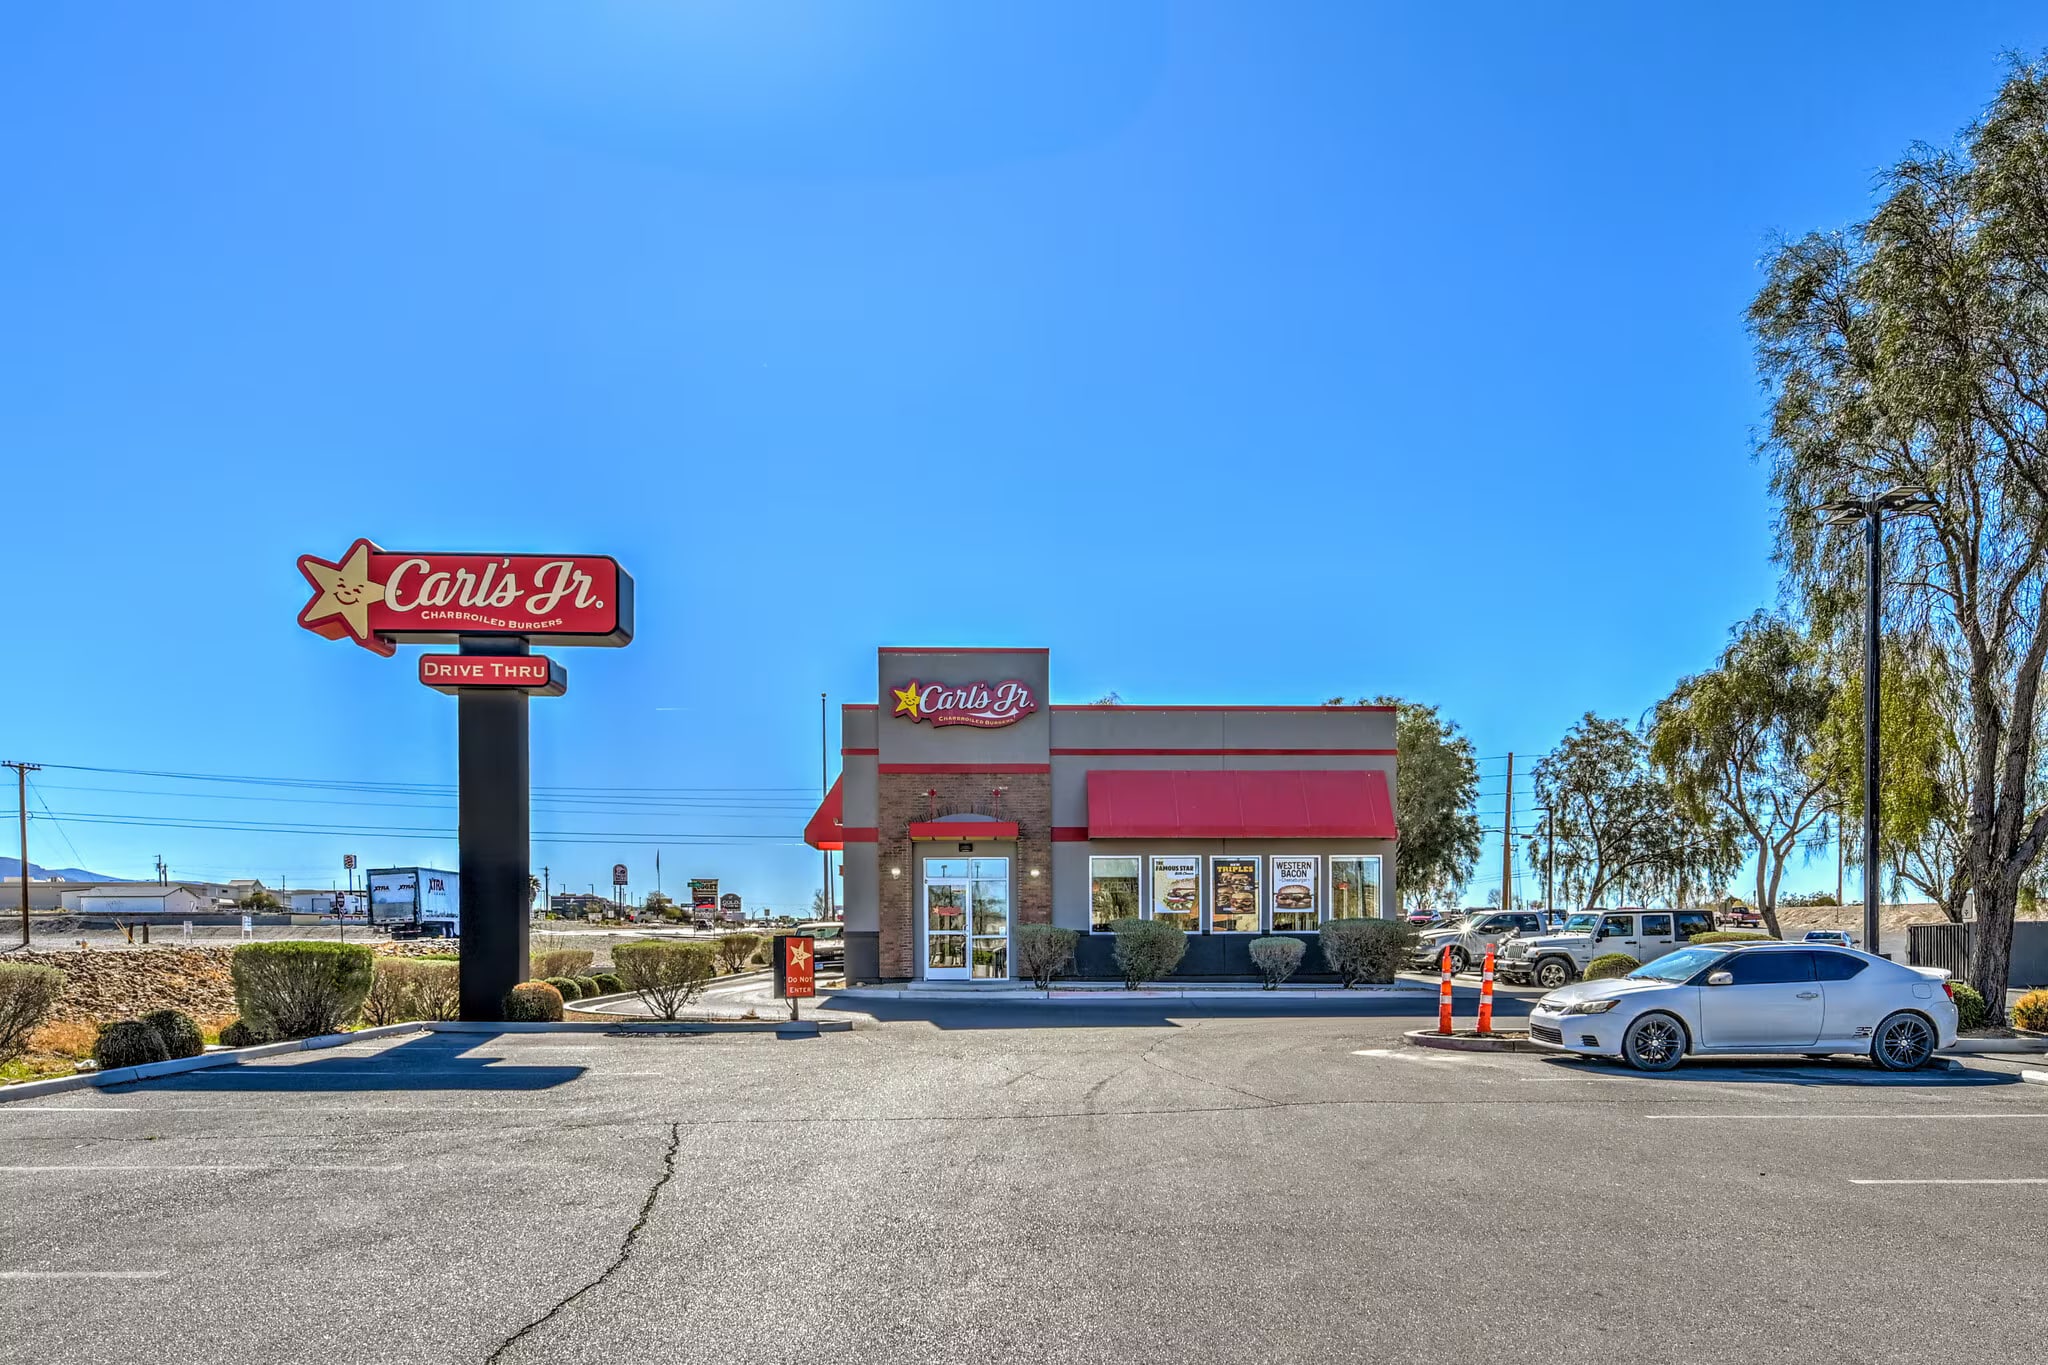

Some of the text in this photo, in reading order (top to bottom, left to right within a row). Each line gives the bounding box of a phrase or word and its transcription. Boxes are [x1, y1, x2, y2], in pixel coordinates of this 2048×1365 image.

[384, 558, 604, 615] Carl's Jr.
[421, 610, 563, 630] CHARBROILED BURGERS
[424, 662, 546, 679] DRIVE THRU
[919, 683, 992, 714] Carl's
[1276, 861, 1312, 870] WESTERN
[1281, 869, 1307, 878] BACON
[428, 877, 445, 894] XTRA
